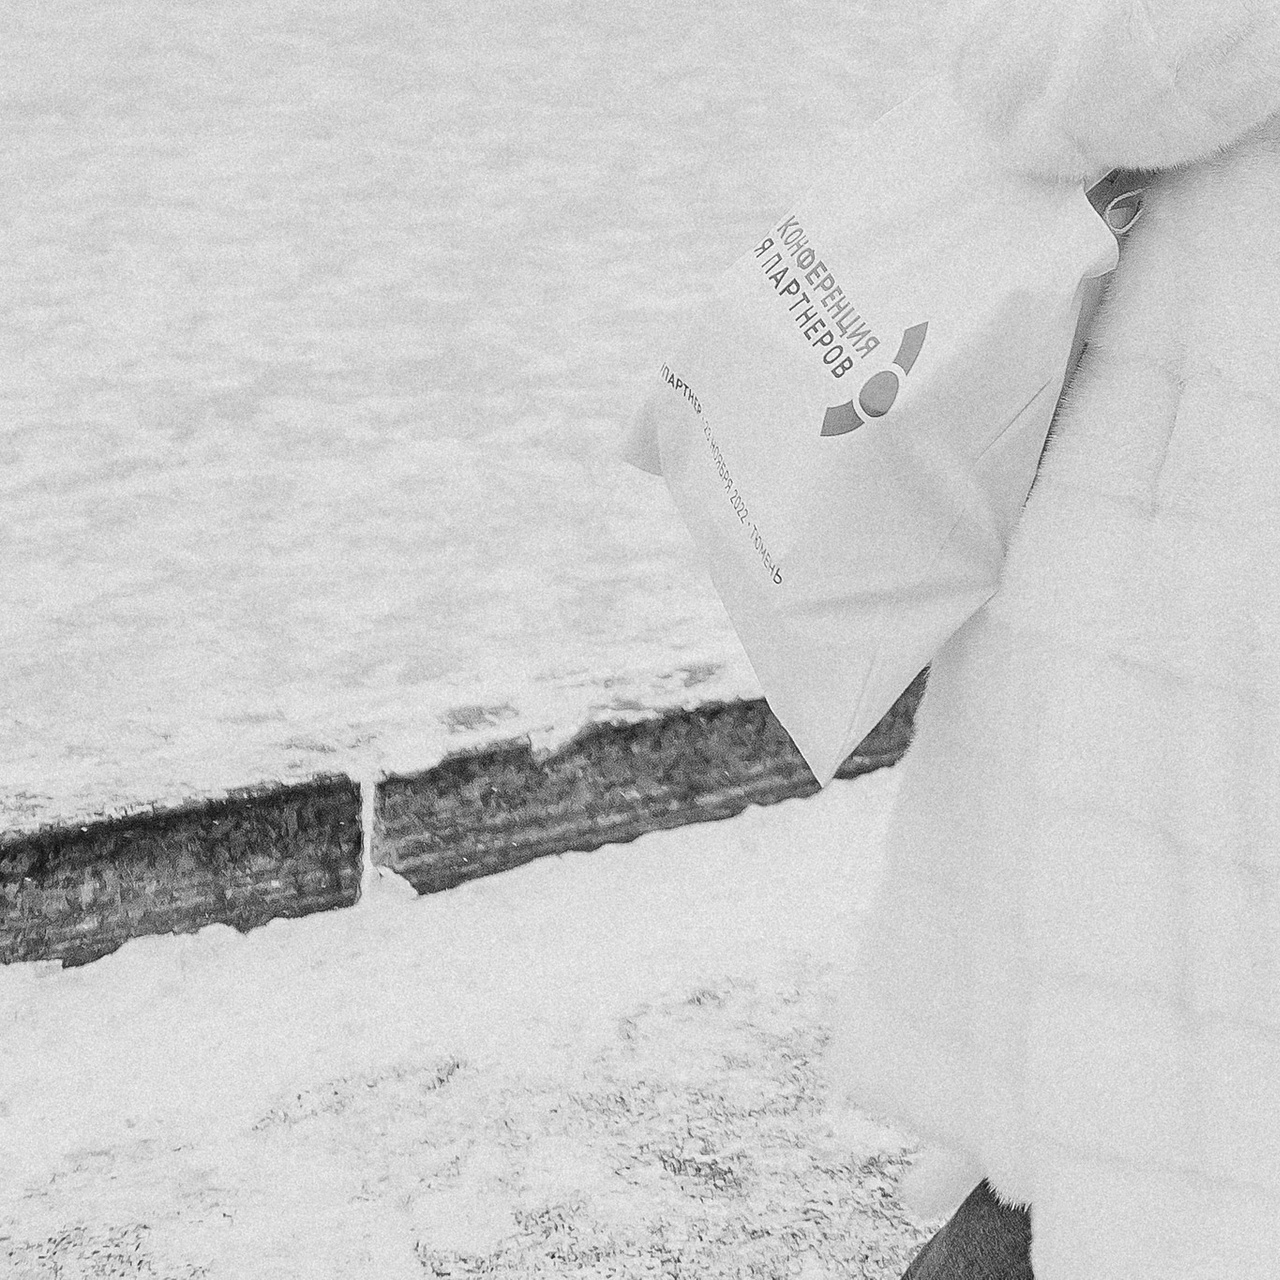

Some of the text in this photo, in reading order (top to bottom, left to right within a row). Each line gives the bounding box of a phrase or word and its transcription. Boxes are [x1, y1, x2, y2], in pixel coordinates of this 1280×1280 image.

[761, 252, 854, 378] ПАРТНЕРОВ
[776, 215, 881, 359] КОНФЕРЕНЦИЯ
[729, 489, 749, 524] 2022
[749, 524, 783, 585] ТЮМЕНЬ
